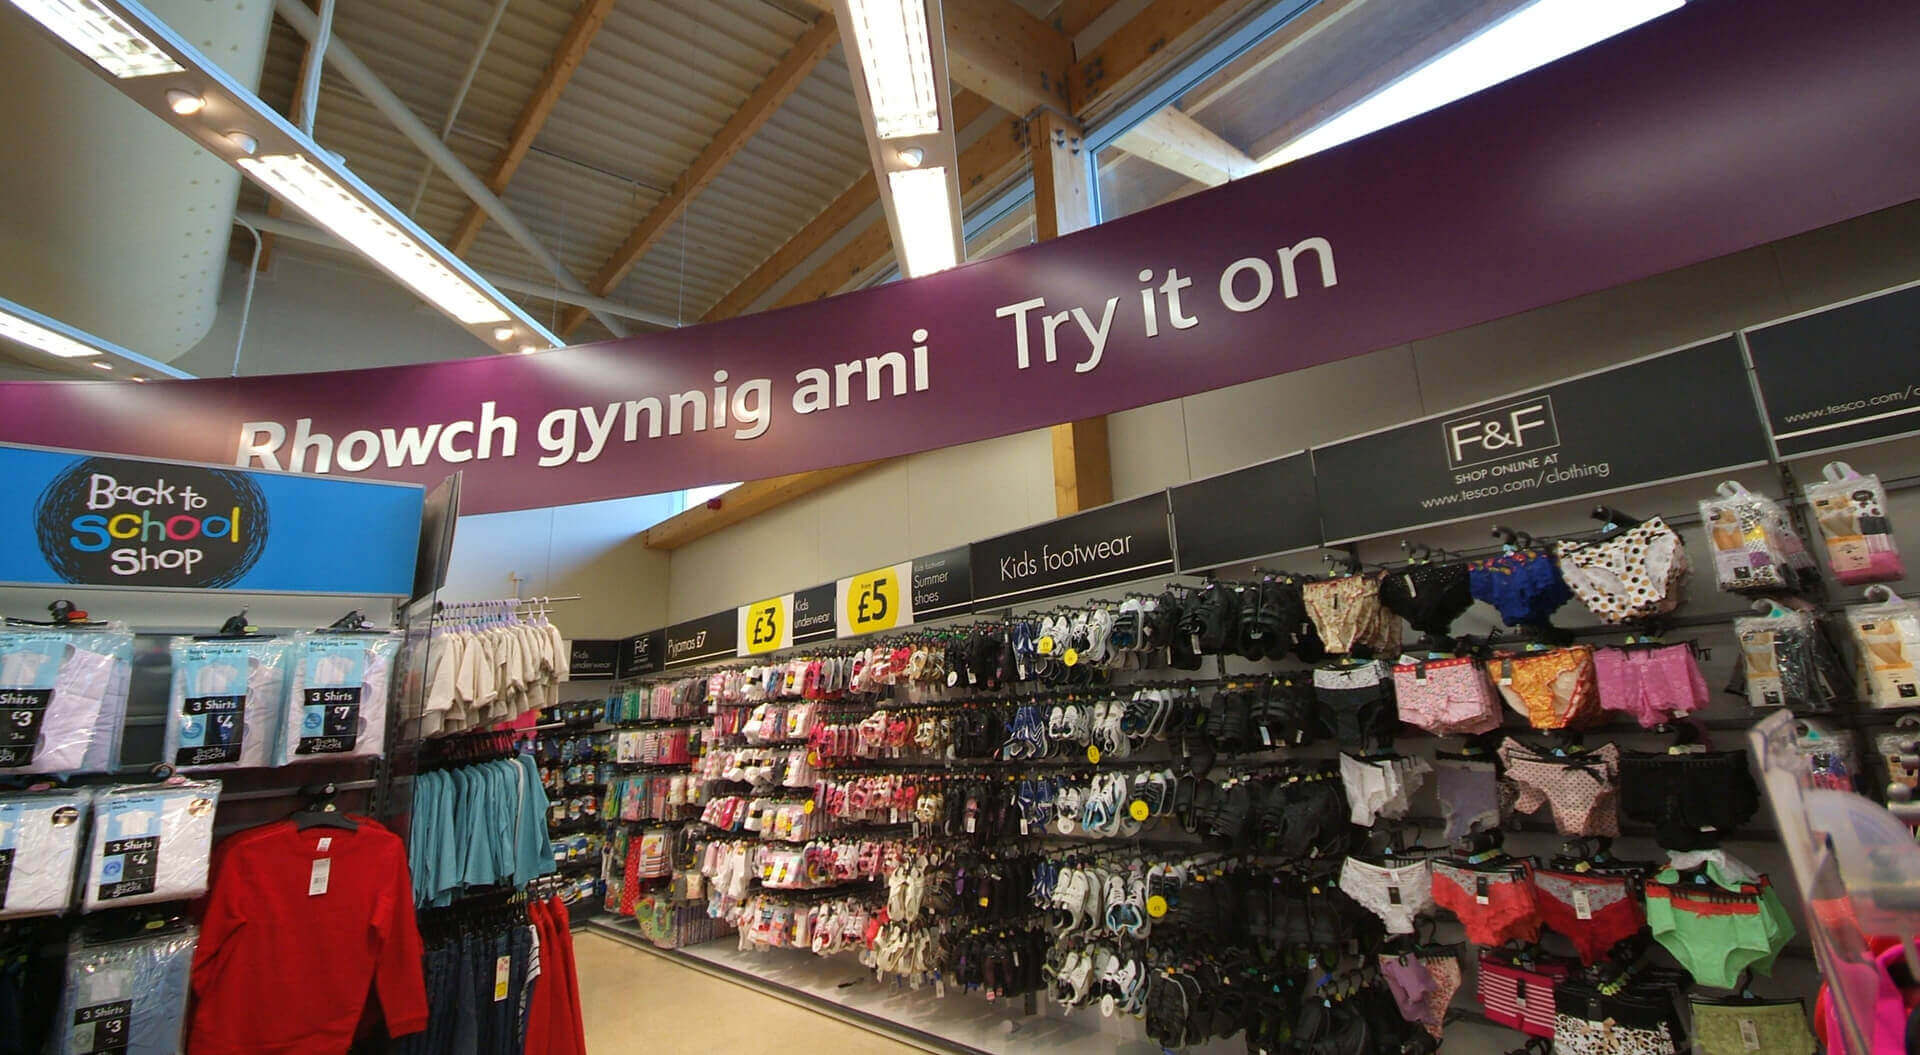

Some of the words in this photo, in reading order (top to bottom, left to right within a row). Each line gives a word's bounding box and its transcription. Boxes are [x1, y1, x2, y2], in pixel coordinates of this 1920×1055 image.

[995, 296, 1120, 373] Try
[1138, 267, 1199, 338] it
[1218, 236, 1338, 313] on
[235, 401, 518, 474] Rhowch
[536, 370, 773, 467] gynnig
[792, 328, 930, 415] arni
[1449, 405, 1545, 462] F&F
[1455, 468, 1488, 485] SHOP
[1491, 457, 1540, 477] ONLINE
[1543, 453, 1559, 466] AT
[86, 473, 175, 510] Back
[179, 485, 208, 511] to
[1420, 462, 1610, 509] www.tesco.com/clothing
[69, 506, 240, 552] School
[110, 547, 203, 575] Shop
[1000, 549, 1037, 582] Kids
[1043, 534, 1132, 572] footwear
[914, 571, 949, 588] Summer
[794, 599, 809, 611] Kids
[857, 578, 887, 624] £5
[914, 591, 939, 605] shoes
[753, 607, 776, 645] £3
[794, 612, 830, 628] underwear
[668, 640, 696, 658] Pyjamas
[1, 693, 38, 705] Shirts
[312, 692, 320, 702] 3
[325, 691, 353, 702] Shirts
[192, 702, 202, 712] 3
[206, 700, 237, 710] Shirts
[334, 706, 350, 719] £7
[11, 711, 33, 727] £3
[217, 715, 234, 729] £4
[112, 843, 120, 851] 3
[124, 840, 152, 850] Shirts
[82, 1010, 91, 1020] 3
[94, 1006, 125, 1018] Shirts
[105, 1020, 122, 1033] £3
